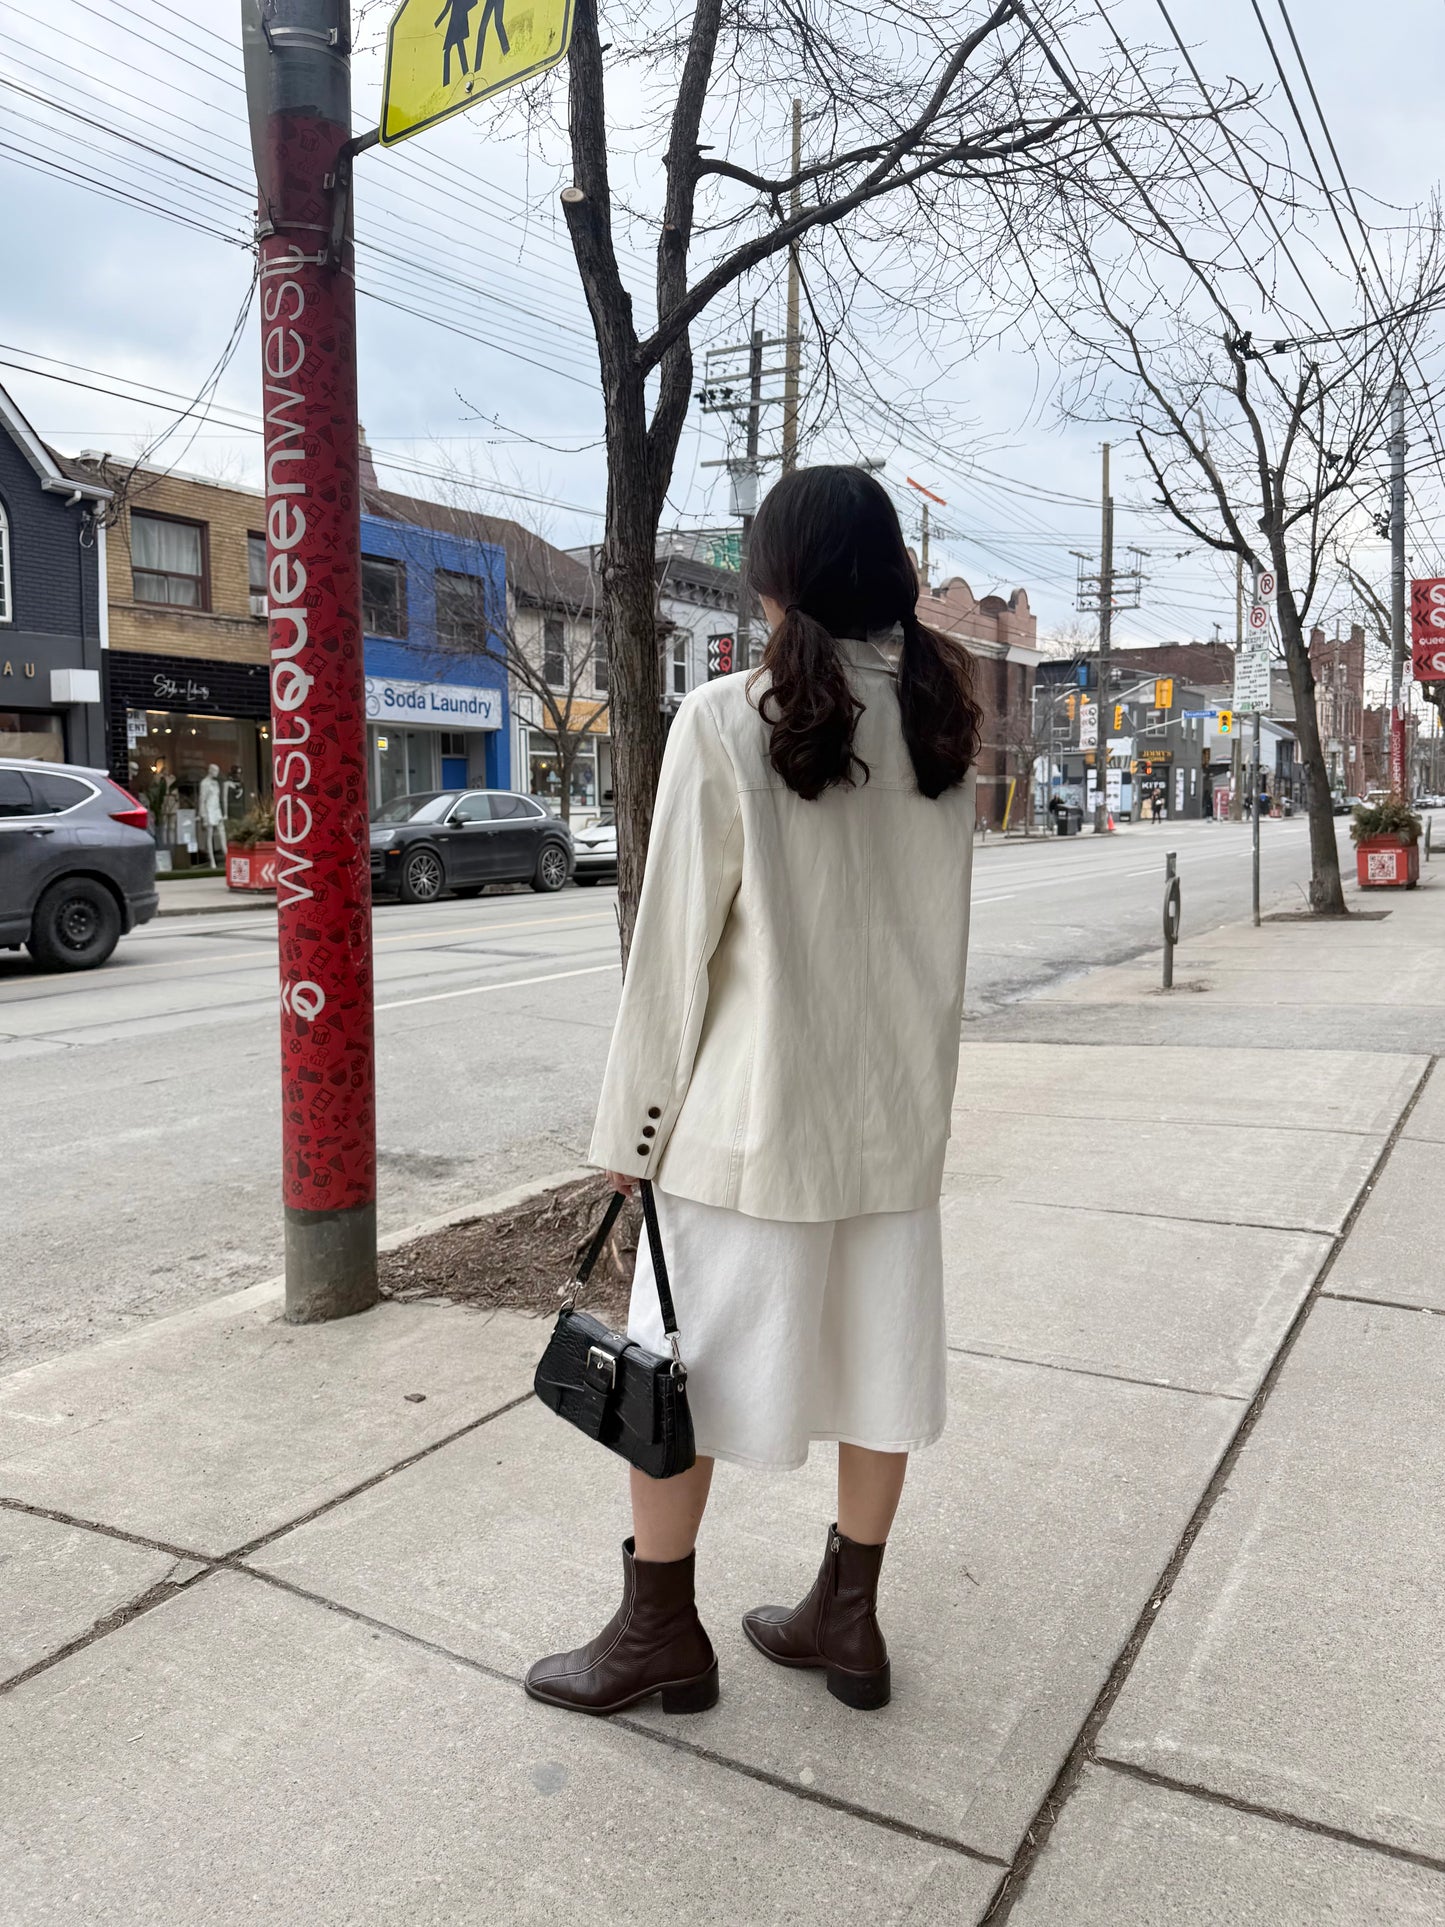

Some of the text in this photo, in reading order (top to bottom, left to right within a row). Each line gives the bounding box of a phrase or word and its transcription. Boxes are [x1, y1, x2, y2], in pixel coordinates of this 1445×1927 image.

[383, 687, 492, 719] Soda Laundry
[1141, 781, 1166, 789] KITS
[291, 980, 326, 1022] Q
